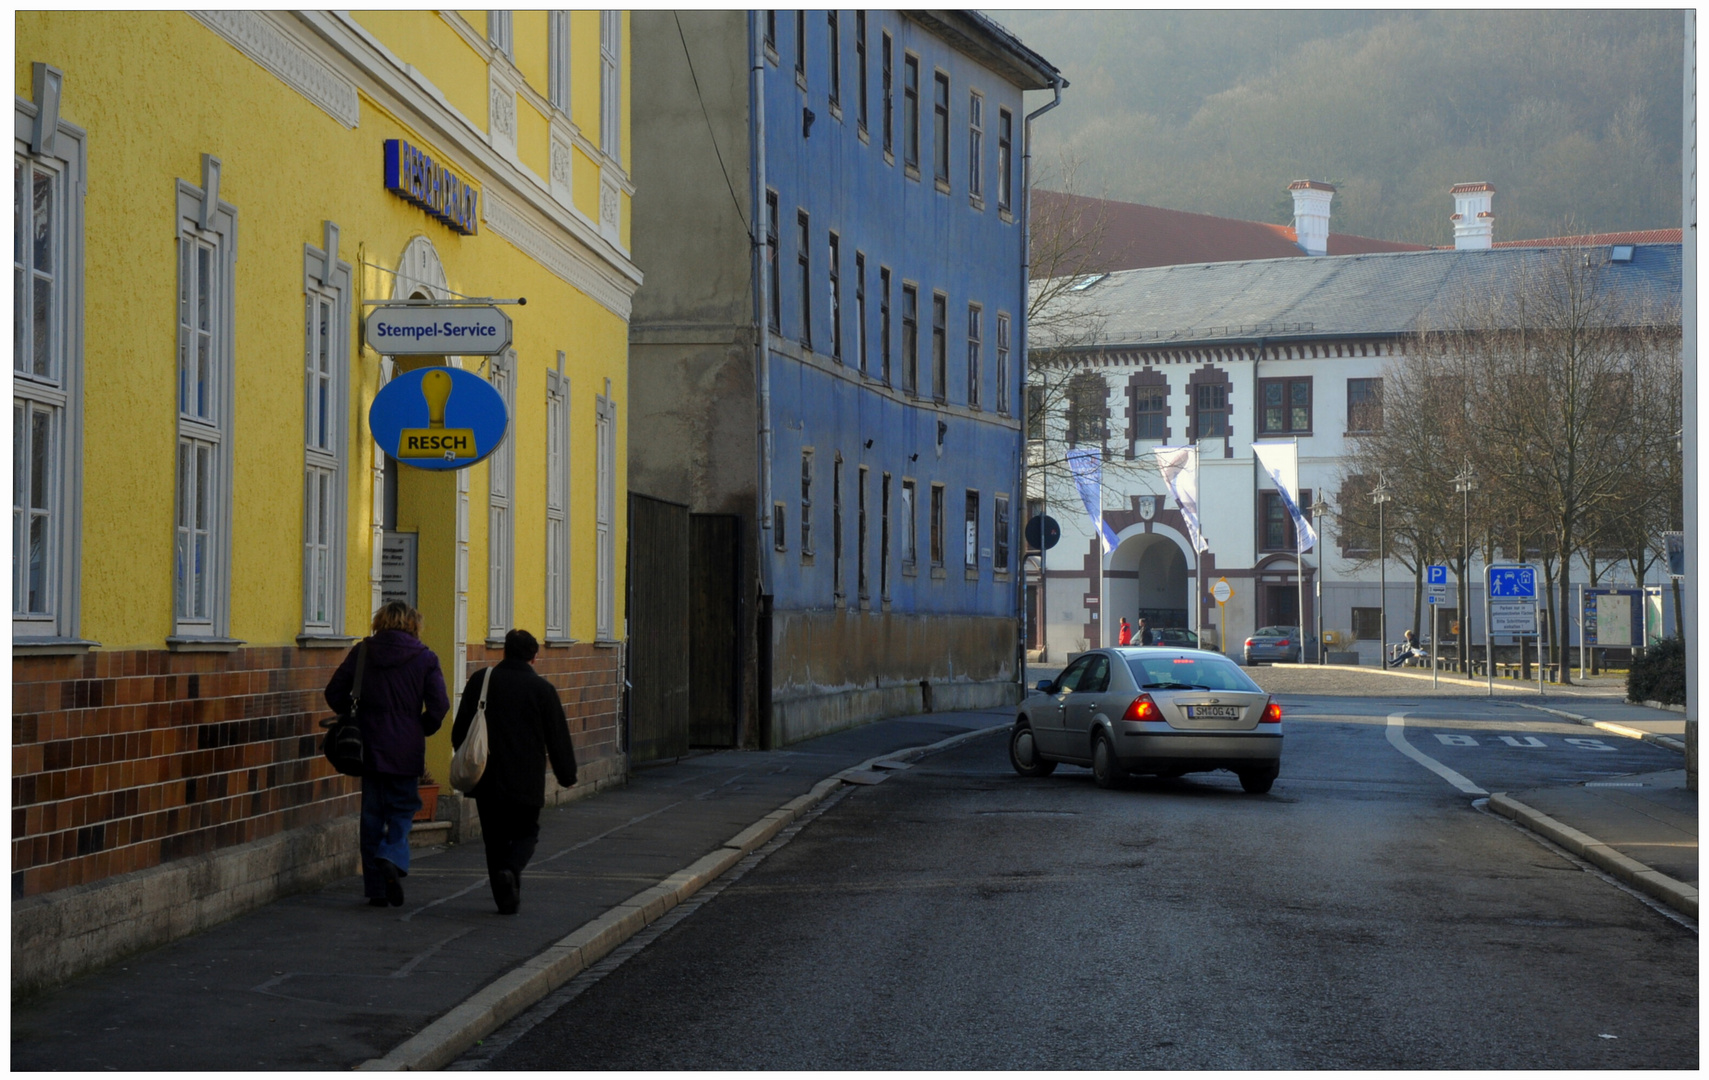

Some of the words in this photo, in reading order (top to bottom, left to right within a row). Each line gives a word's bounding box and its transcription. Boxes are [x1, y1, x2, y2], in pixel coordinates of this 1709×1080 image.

[377, 322, 496, 341] Stempel-Service
[408, 436, 467, 449] RESCH
[1432, 567, 1442, 582] P
[1196, 707, 1208, 716] SM
[1212, 707, 1224, 716] OG
[1225, 707, 1236, 716] 41
[1433, 733, 1619, 751] BUS
